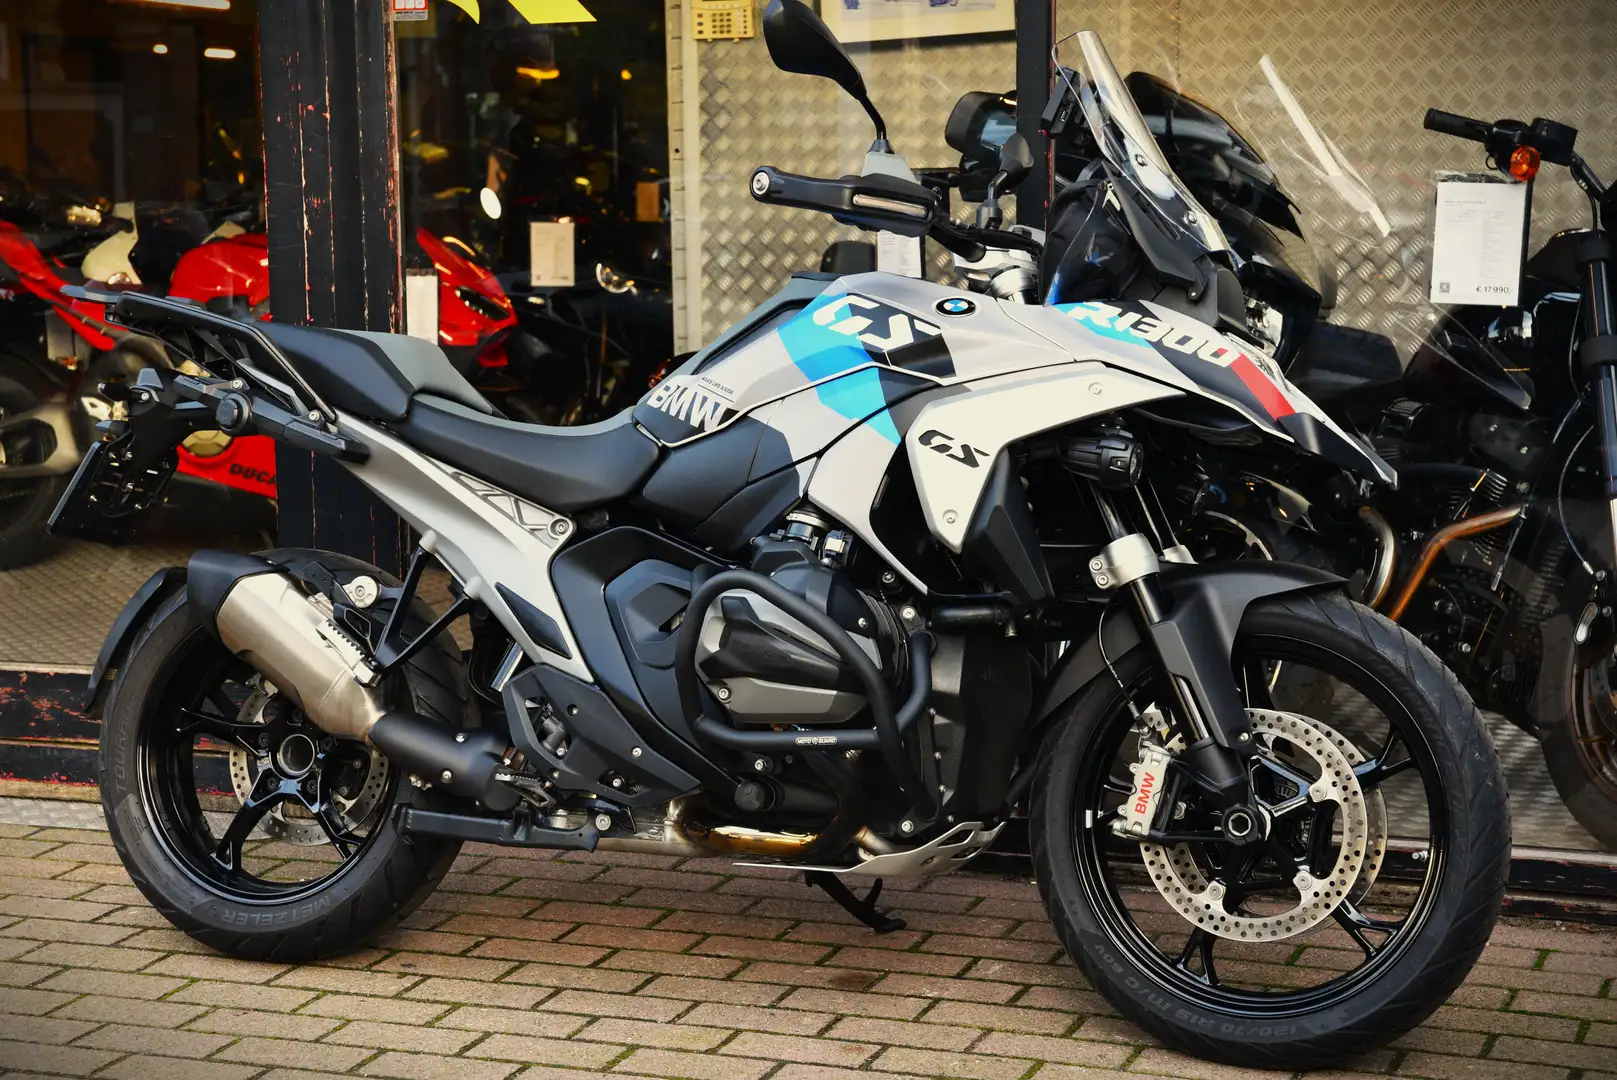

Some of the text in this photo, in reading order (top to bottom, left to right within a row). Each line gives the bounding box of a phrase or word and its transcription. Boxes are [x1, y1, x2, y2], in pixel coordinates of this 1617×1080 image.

[813, 294, 943, 351] GS
[1066, 301, 1242, 368] R1300
[647, 382, 728, 432] BMW
[918, 429, 990, 468] GS
[1134, 771, 1155, 815] BMW
[220, 895, 330, 926] METZELER
[1220, 1022, 1299, 1036] 120/70
